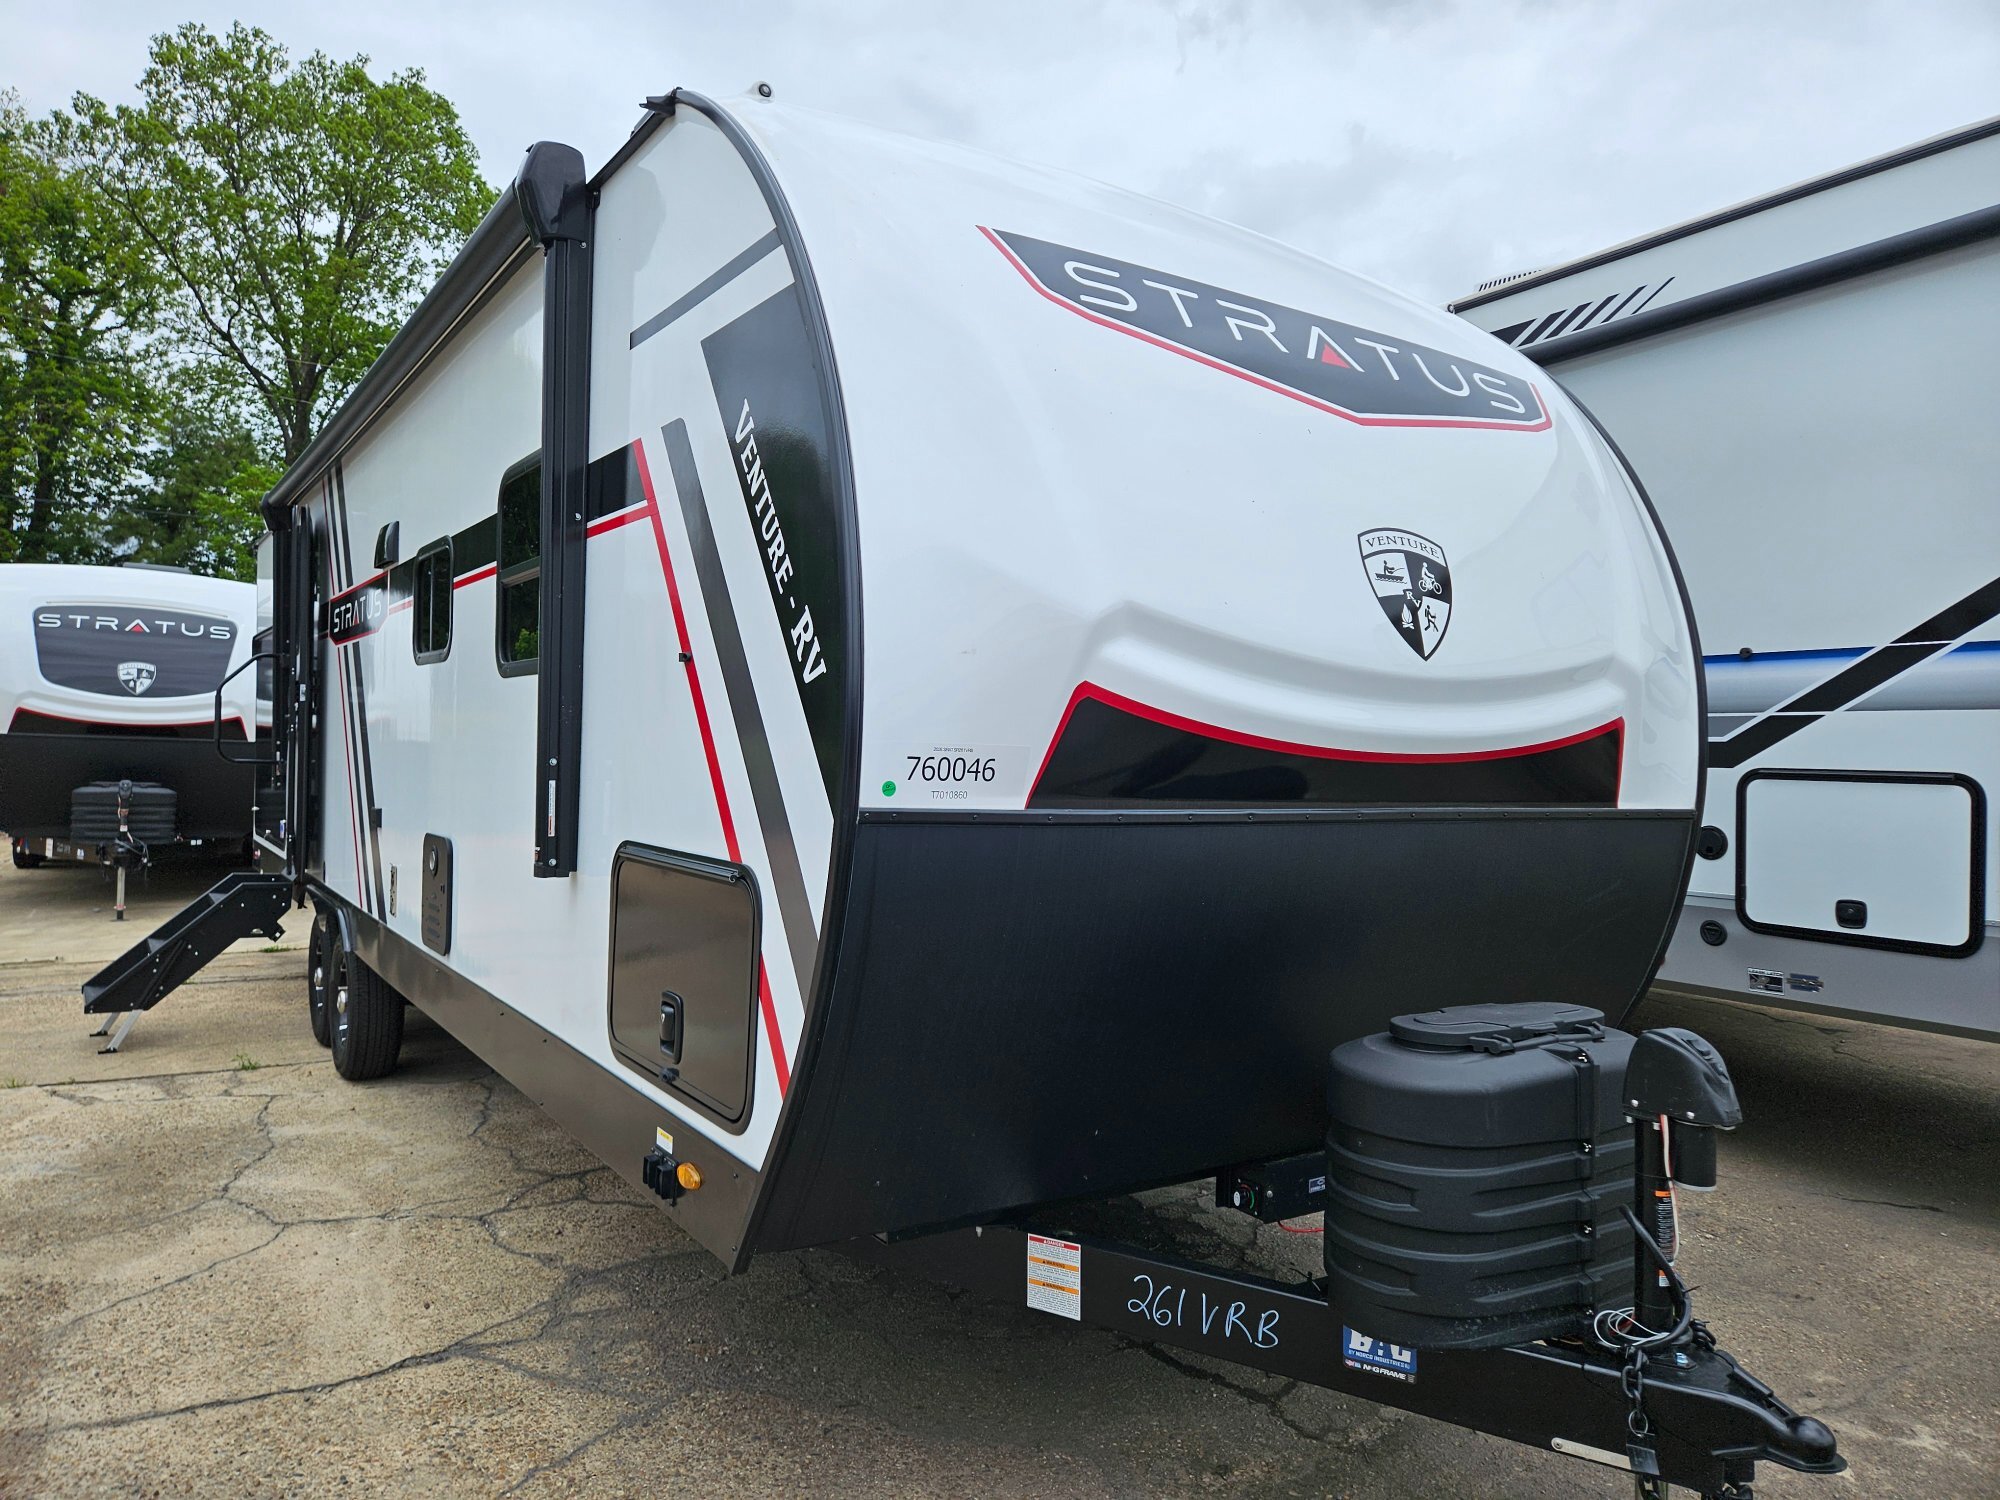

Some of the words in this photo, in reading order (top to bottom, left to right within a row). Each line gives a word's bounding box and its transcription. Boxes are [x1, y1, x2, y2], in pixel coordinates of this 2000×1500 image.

[1063, 260, 1526, 414] STRATUS
[734, 398, 794, 594] VENTURE
[790, 604, 827, 685] RV
[1365, 535, 1440, 559] VENTURE
[333, 588, 382, 633] STRATUS
[38, 613, 232, 640] STRATUS
[906, 755, 996, 782] 760046
[1355, 1351, 1374, 1360] NORCO
